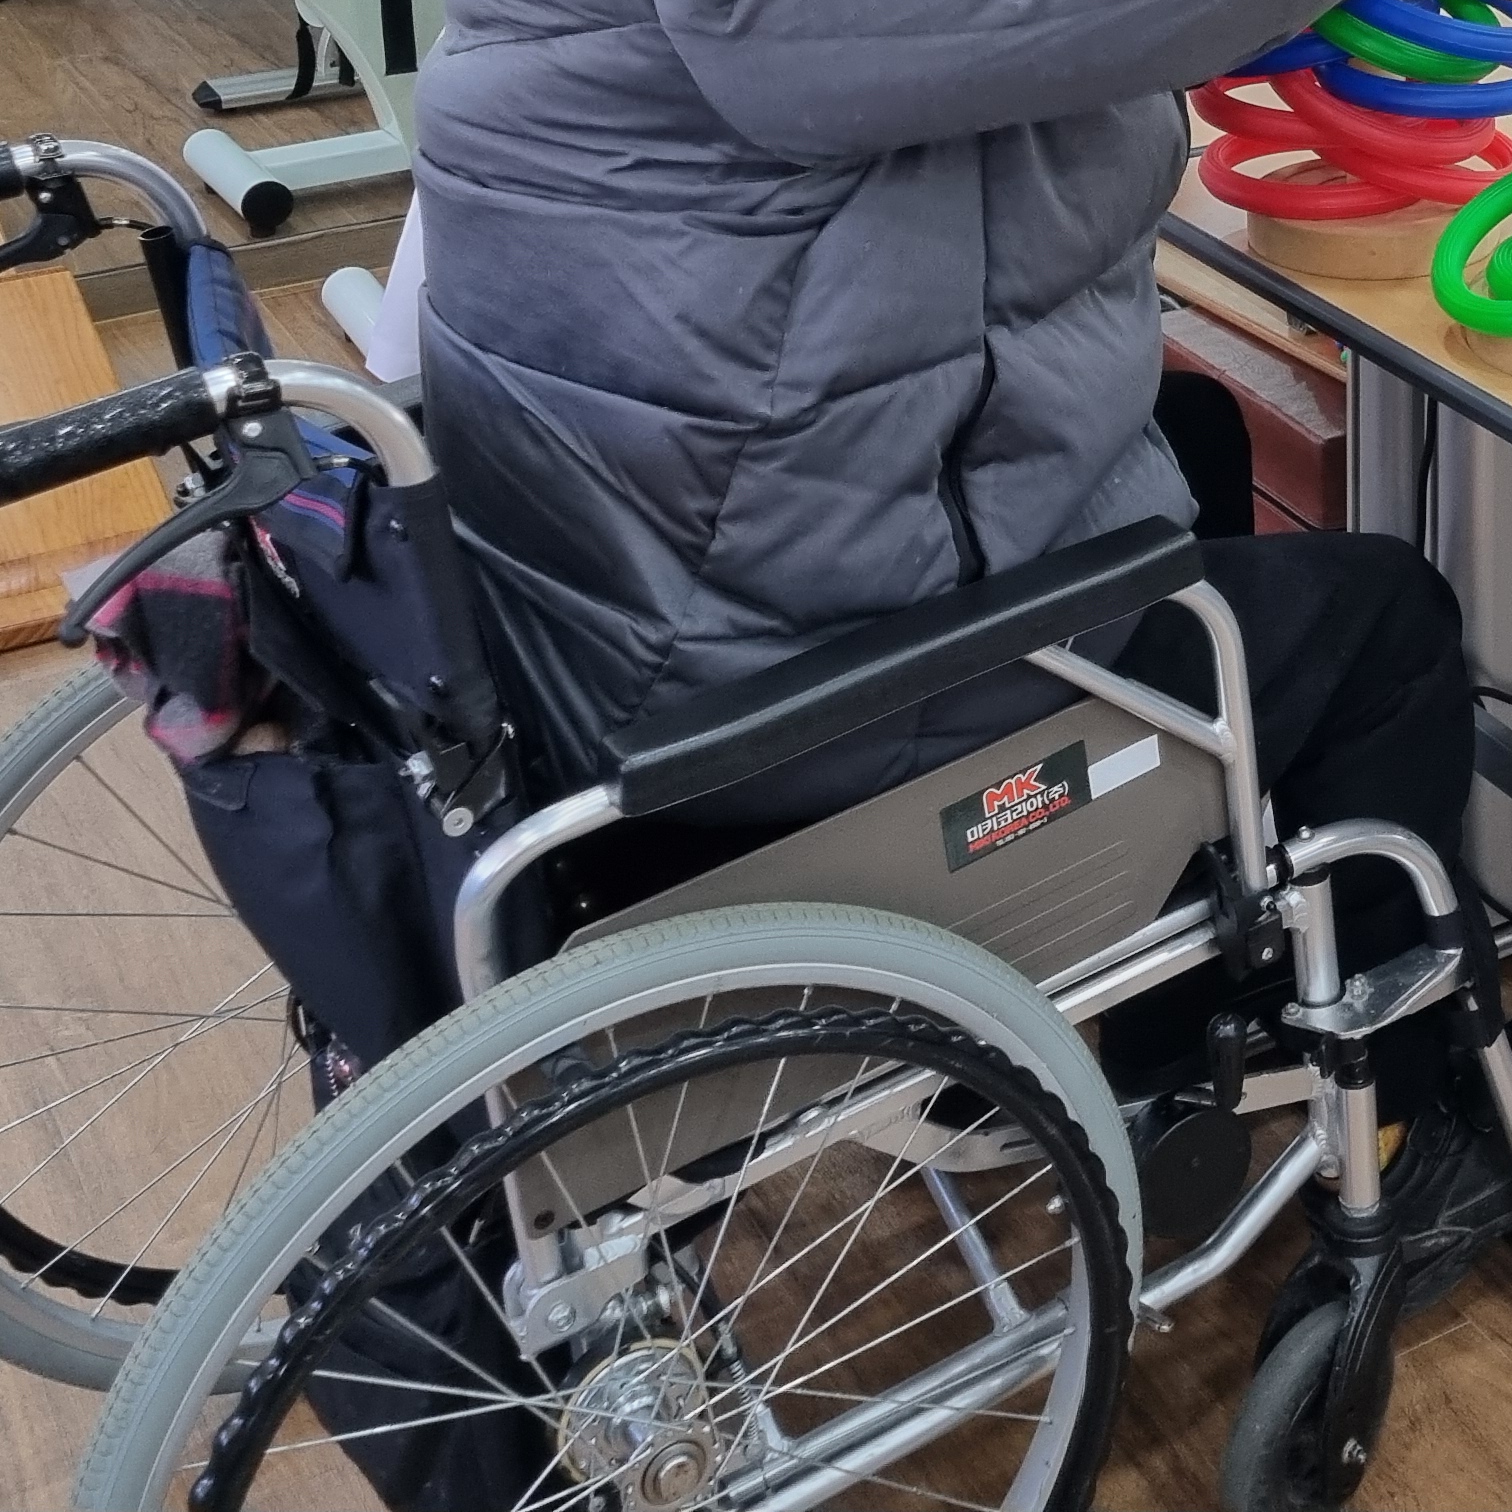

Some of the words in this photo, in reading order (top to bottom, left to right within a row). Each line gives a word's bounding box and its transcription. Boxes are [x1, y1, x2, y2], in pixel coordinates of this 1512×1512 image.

[966, 780, 1069, 843] 미키코리아(주)
[983, 763, 1048, 818] MK
[990, 817, 1028, 841] KOREA
